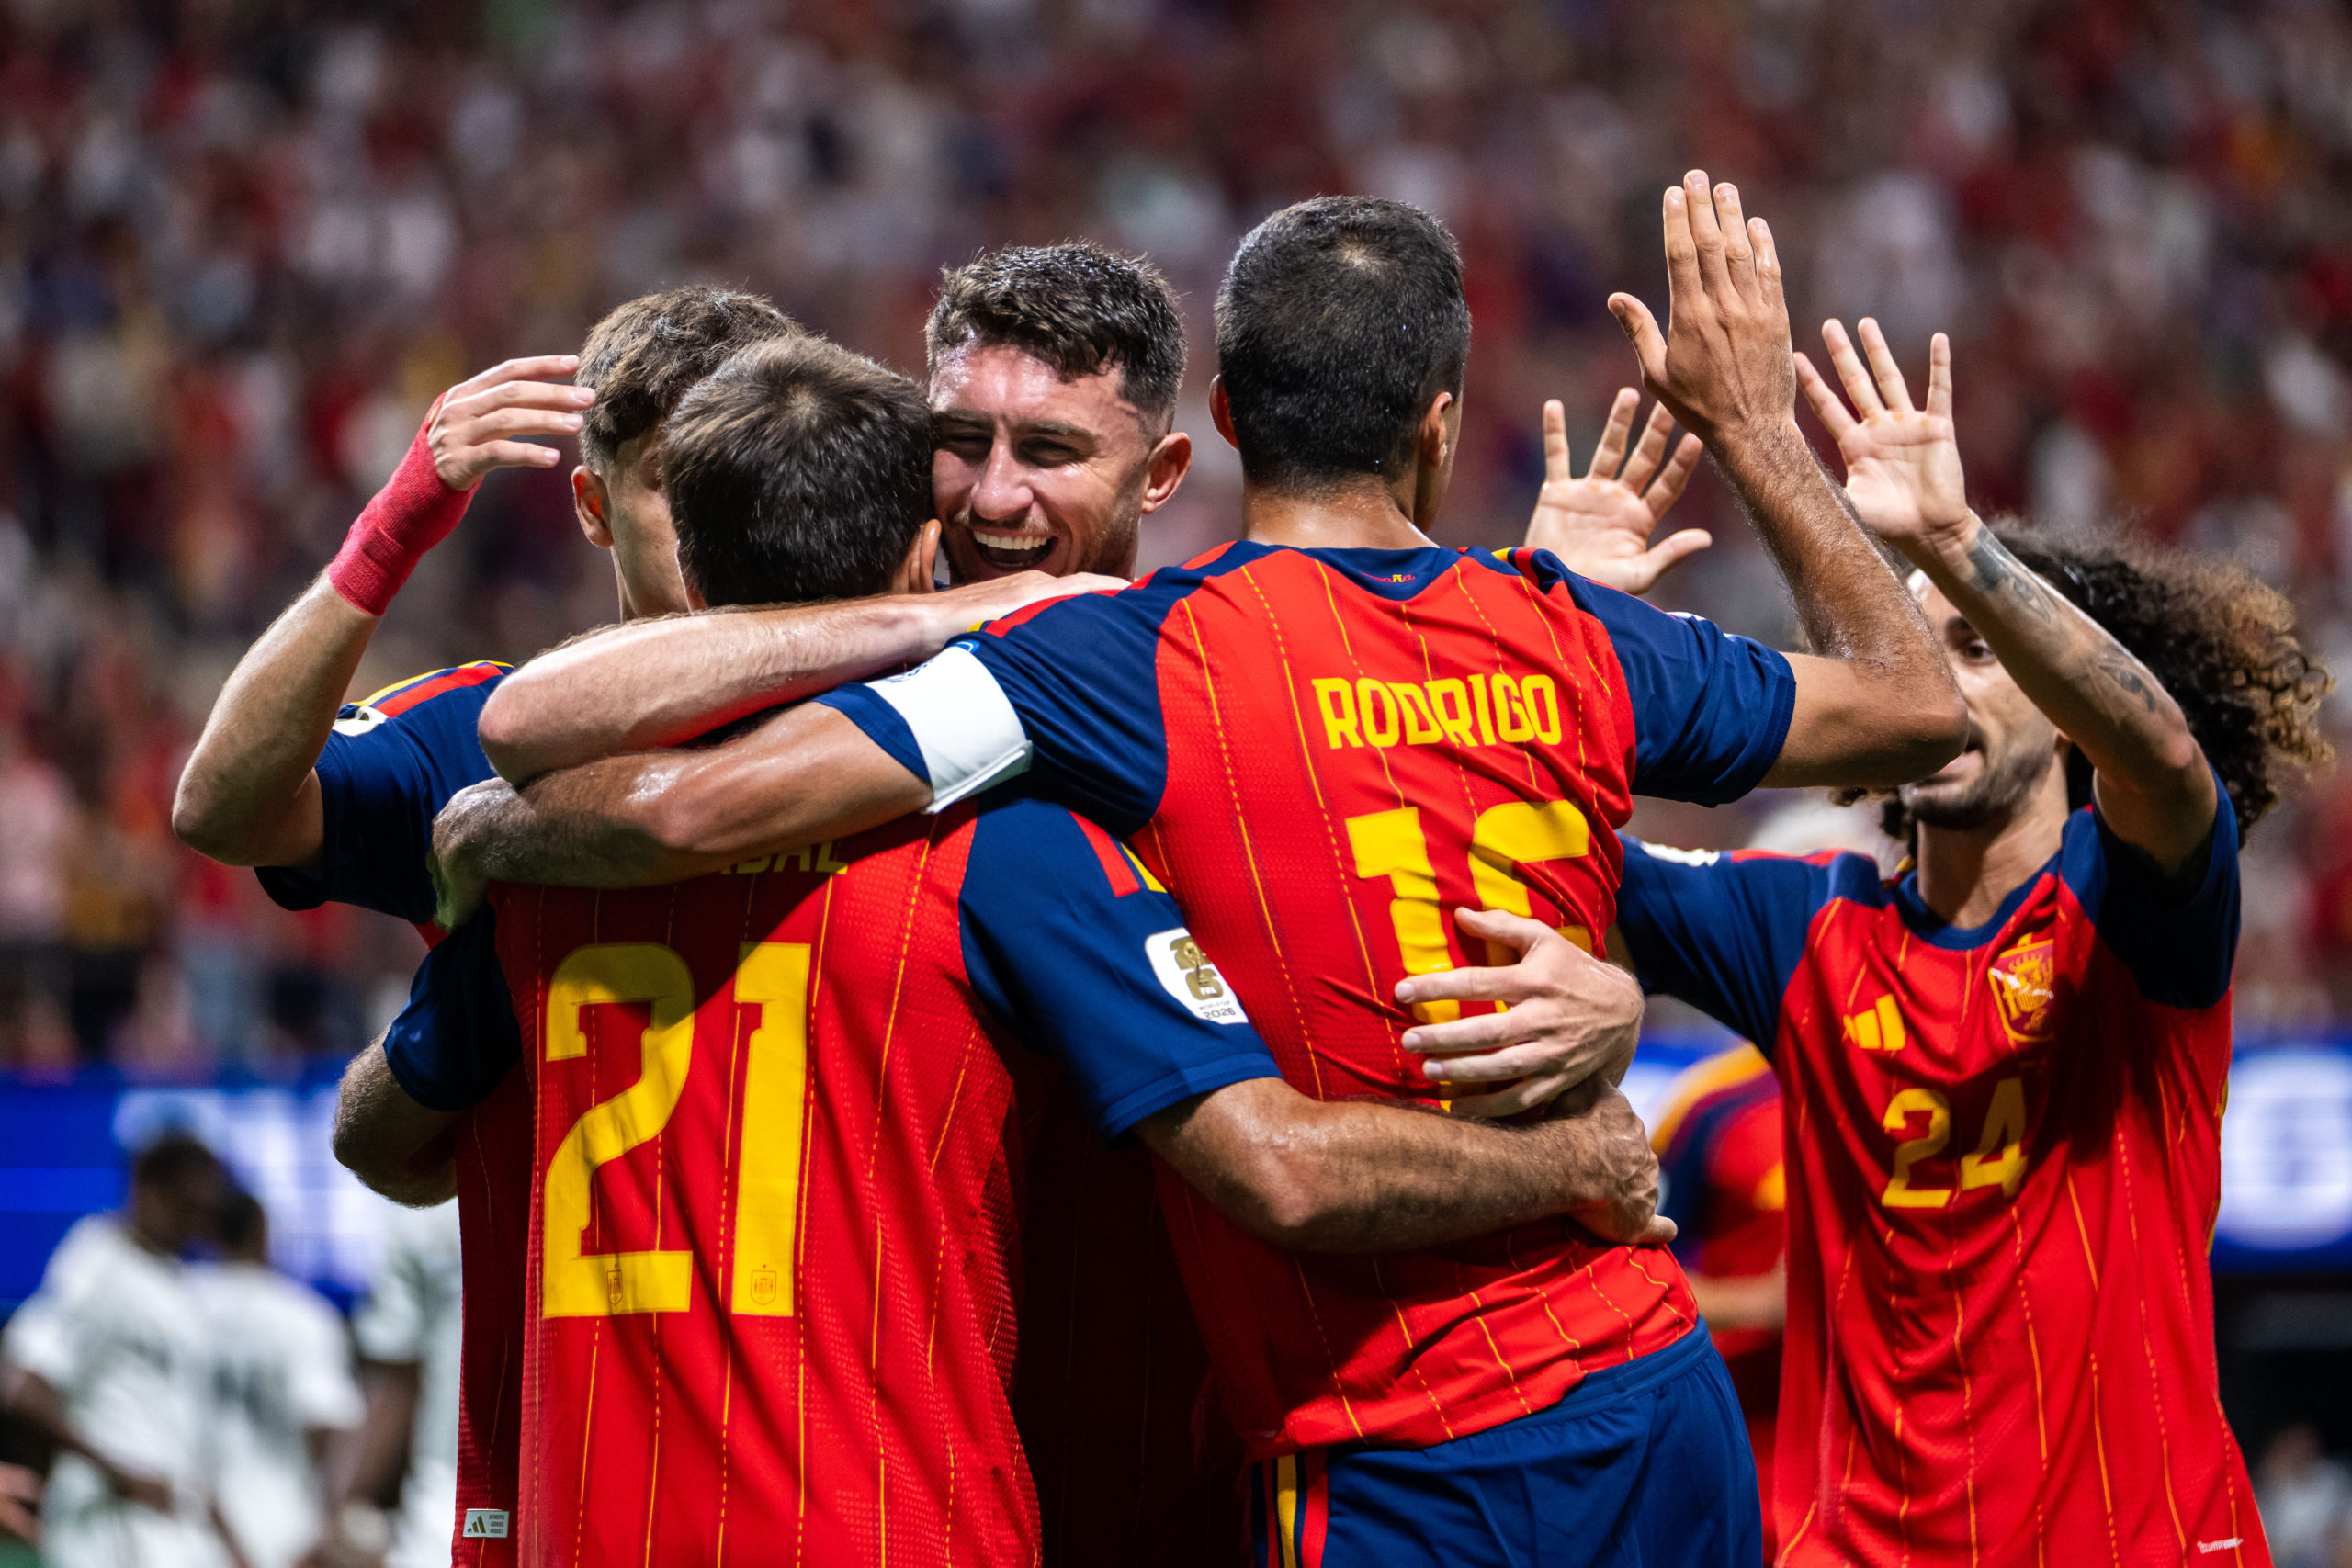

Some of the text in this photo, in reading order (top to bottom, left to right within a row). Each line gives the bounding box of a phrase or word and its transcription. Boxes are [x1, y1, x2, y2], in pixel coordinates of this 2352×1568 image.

[1311, 673, 1562, 750] RODRIGO
[542, 942, 812, 1320] 21
[1881, 1077, 2029, 1208] 24
